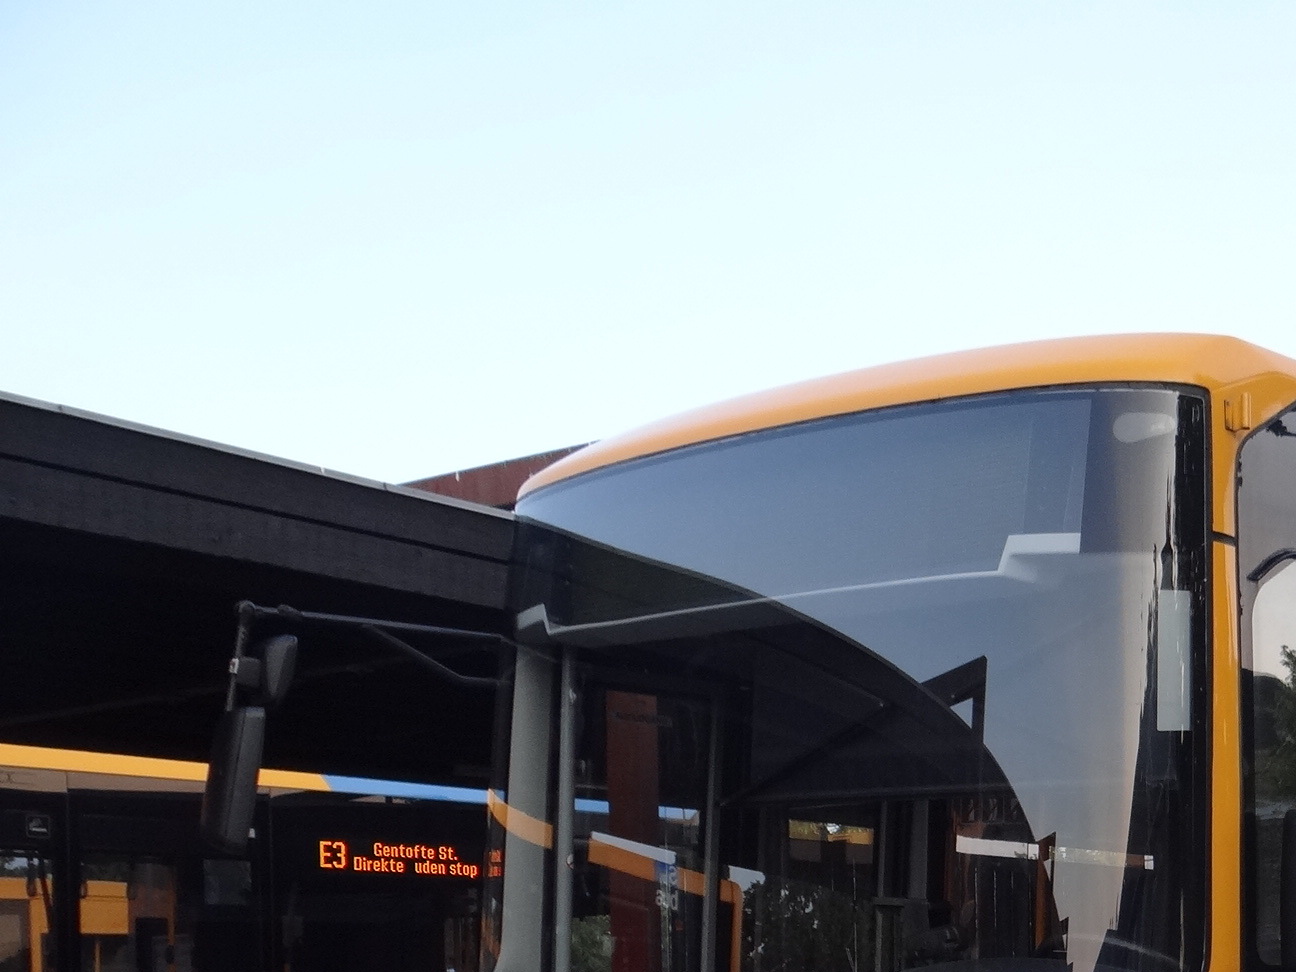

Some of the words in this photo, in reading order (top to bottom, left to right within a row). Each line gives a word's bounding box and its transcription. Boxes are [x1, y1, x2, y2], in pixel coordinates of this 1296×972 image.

[319, 840, 346, 869] E3
[373, 842, 435, 860] Gentofte
[438, 846, 458, 861] St.
[353, 856, 404, 873] Direkte
[414, 860, 446, 875] uden
[450, 863, 478, 878] stop
